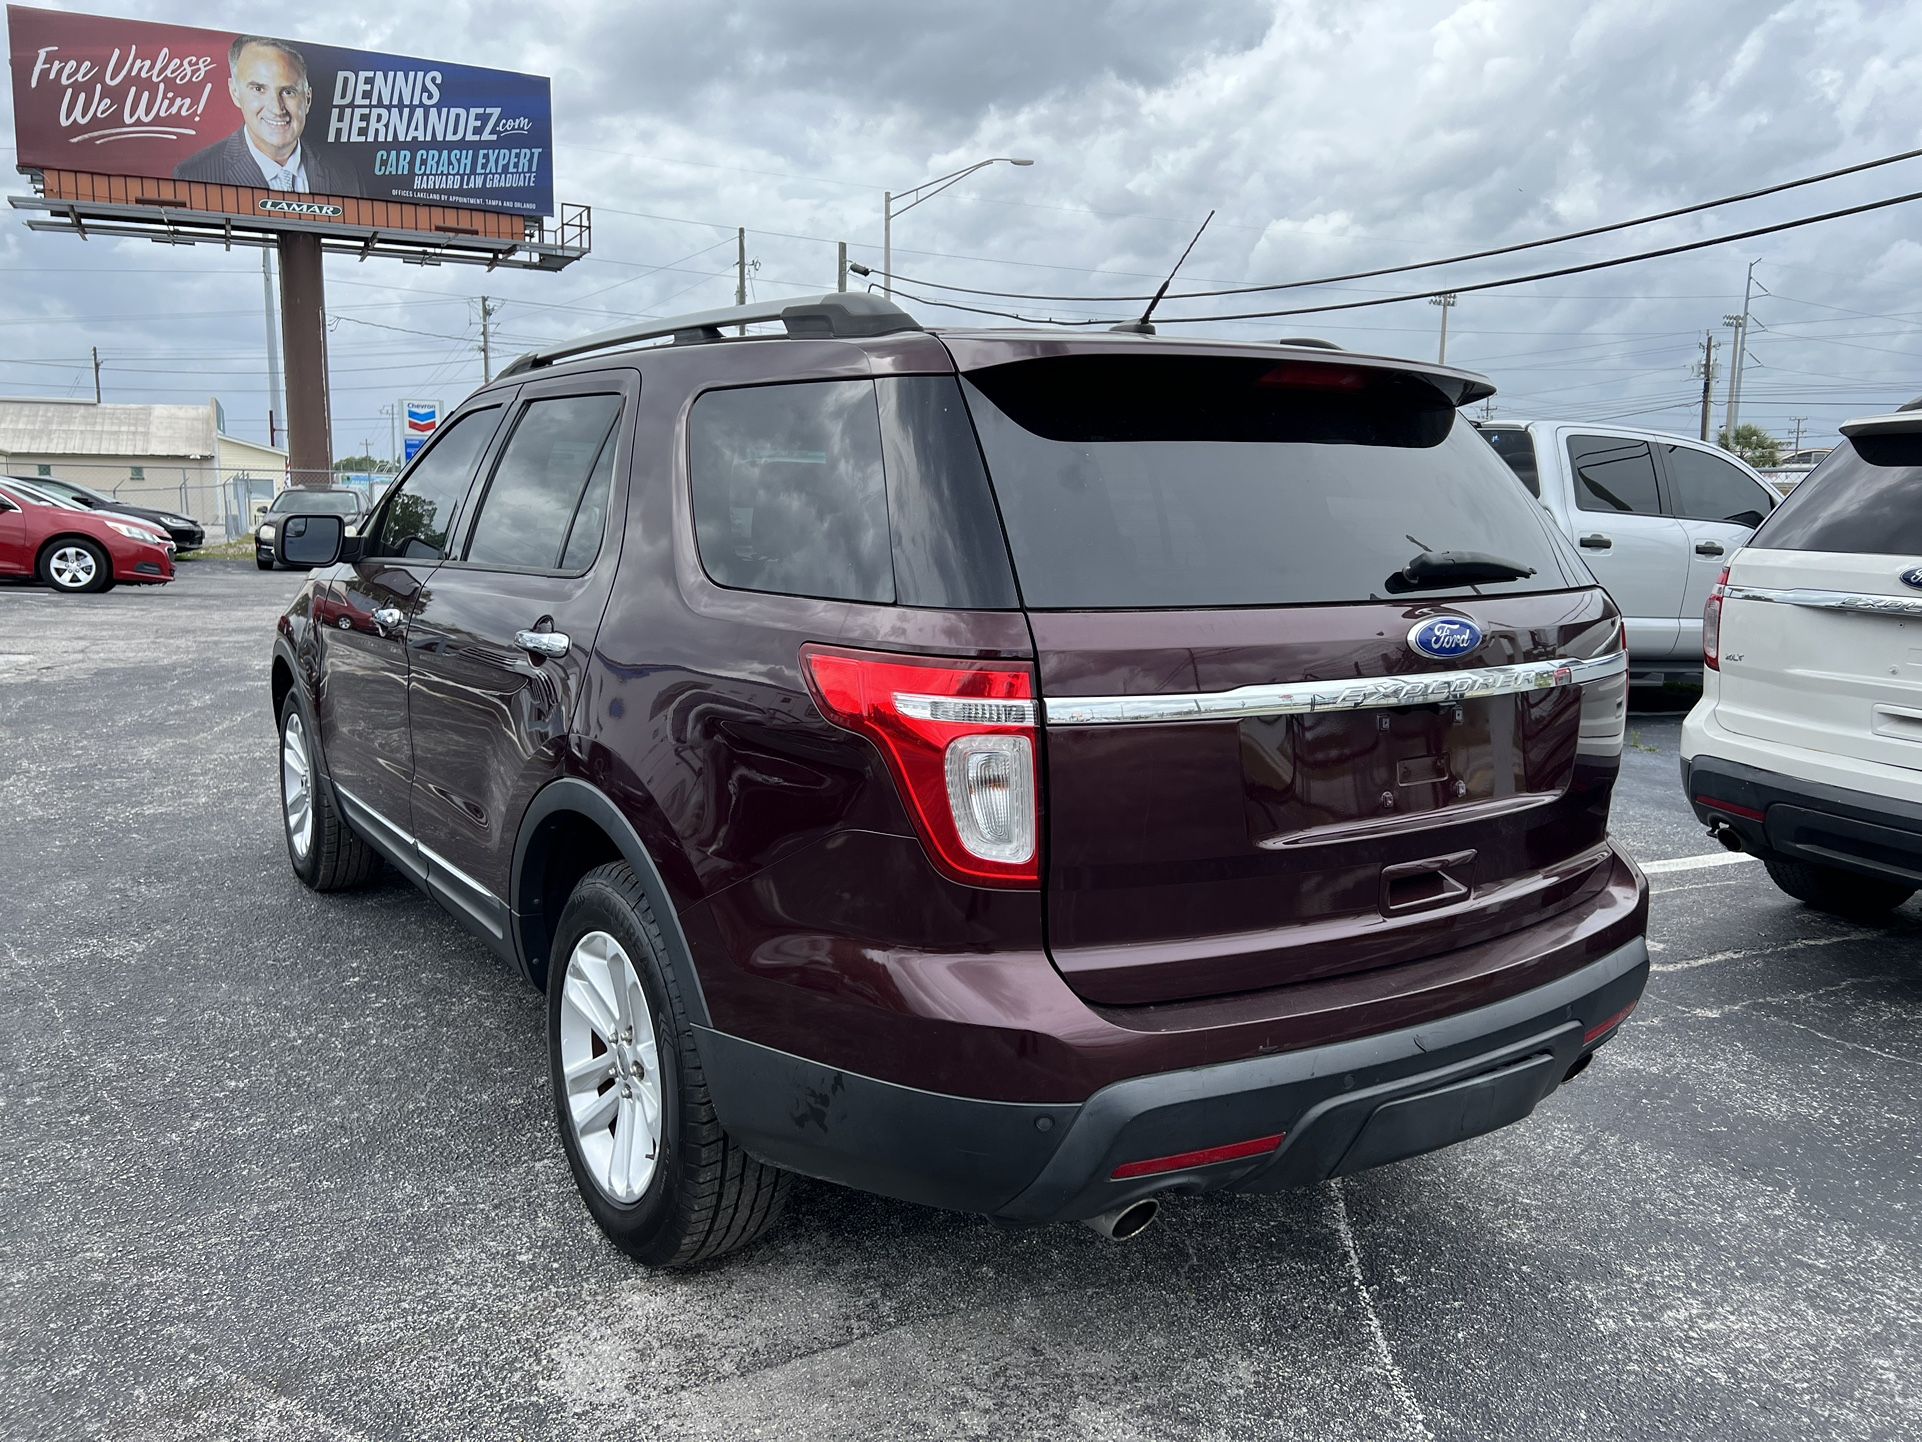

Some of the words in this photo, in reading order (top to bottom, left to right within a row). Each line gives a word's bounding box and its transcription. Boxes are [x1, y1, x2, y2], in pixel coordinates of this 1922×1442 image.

[31, 46, 99, 88] Free
[105, 44, 217, 86] Unless
[332, 70, 443, 106] DENNIS
[60, 83, 118, 127] We
[123, 82, 212, 125] Win!
[374, 150, 411, 175] CAR
[414, 149, 473, 175] CRASH
[476, 148, 542, 174] EXPERT
[413, 175, 461, 190] HARVARD
[463, 175, 484, 189] LAW
[486, 173, 537, 188] GRADUATE
[265, 201, 334, 215] LAMAR
[391, 189, 413, 198] OFFICES
[413, 191, 441, 201] LAKELAND
[485, 198, 502, 207] TAMPA
[503, 200, 513, 208] AND
[514, 201, 537, 210] ORLANDO
[1431, 623, 1471, 649] Ford
[1335, 670, 1537, 705] EXPLORER
